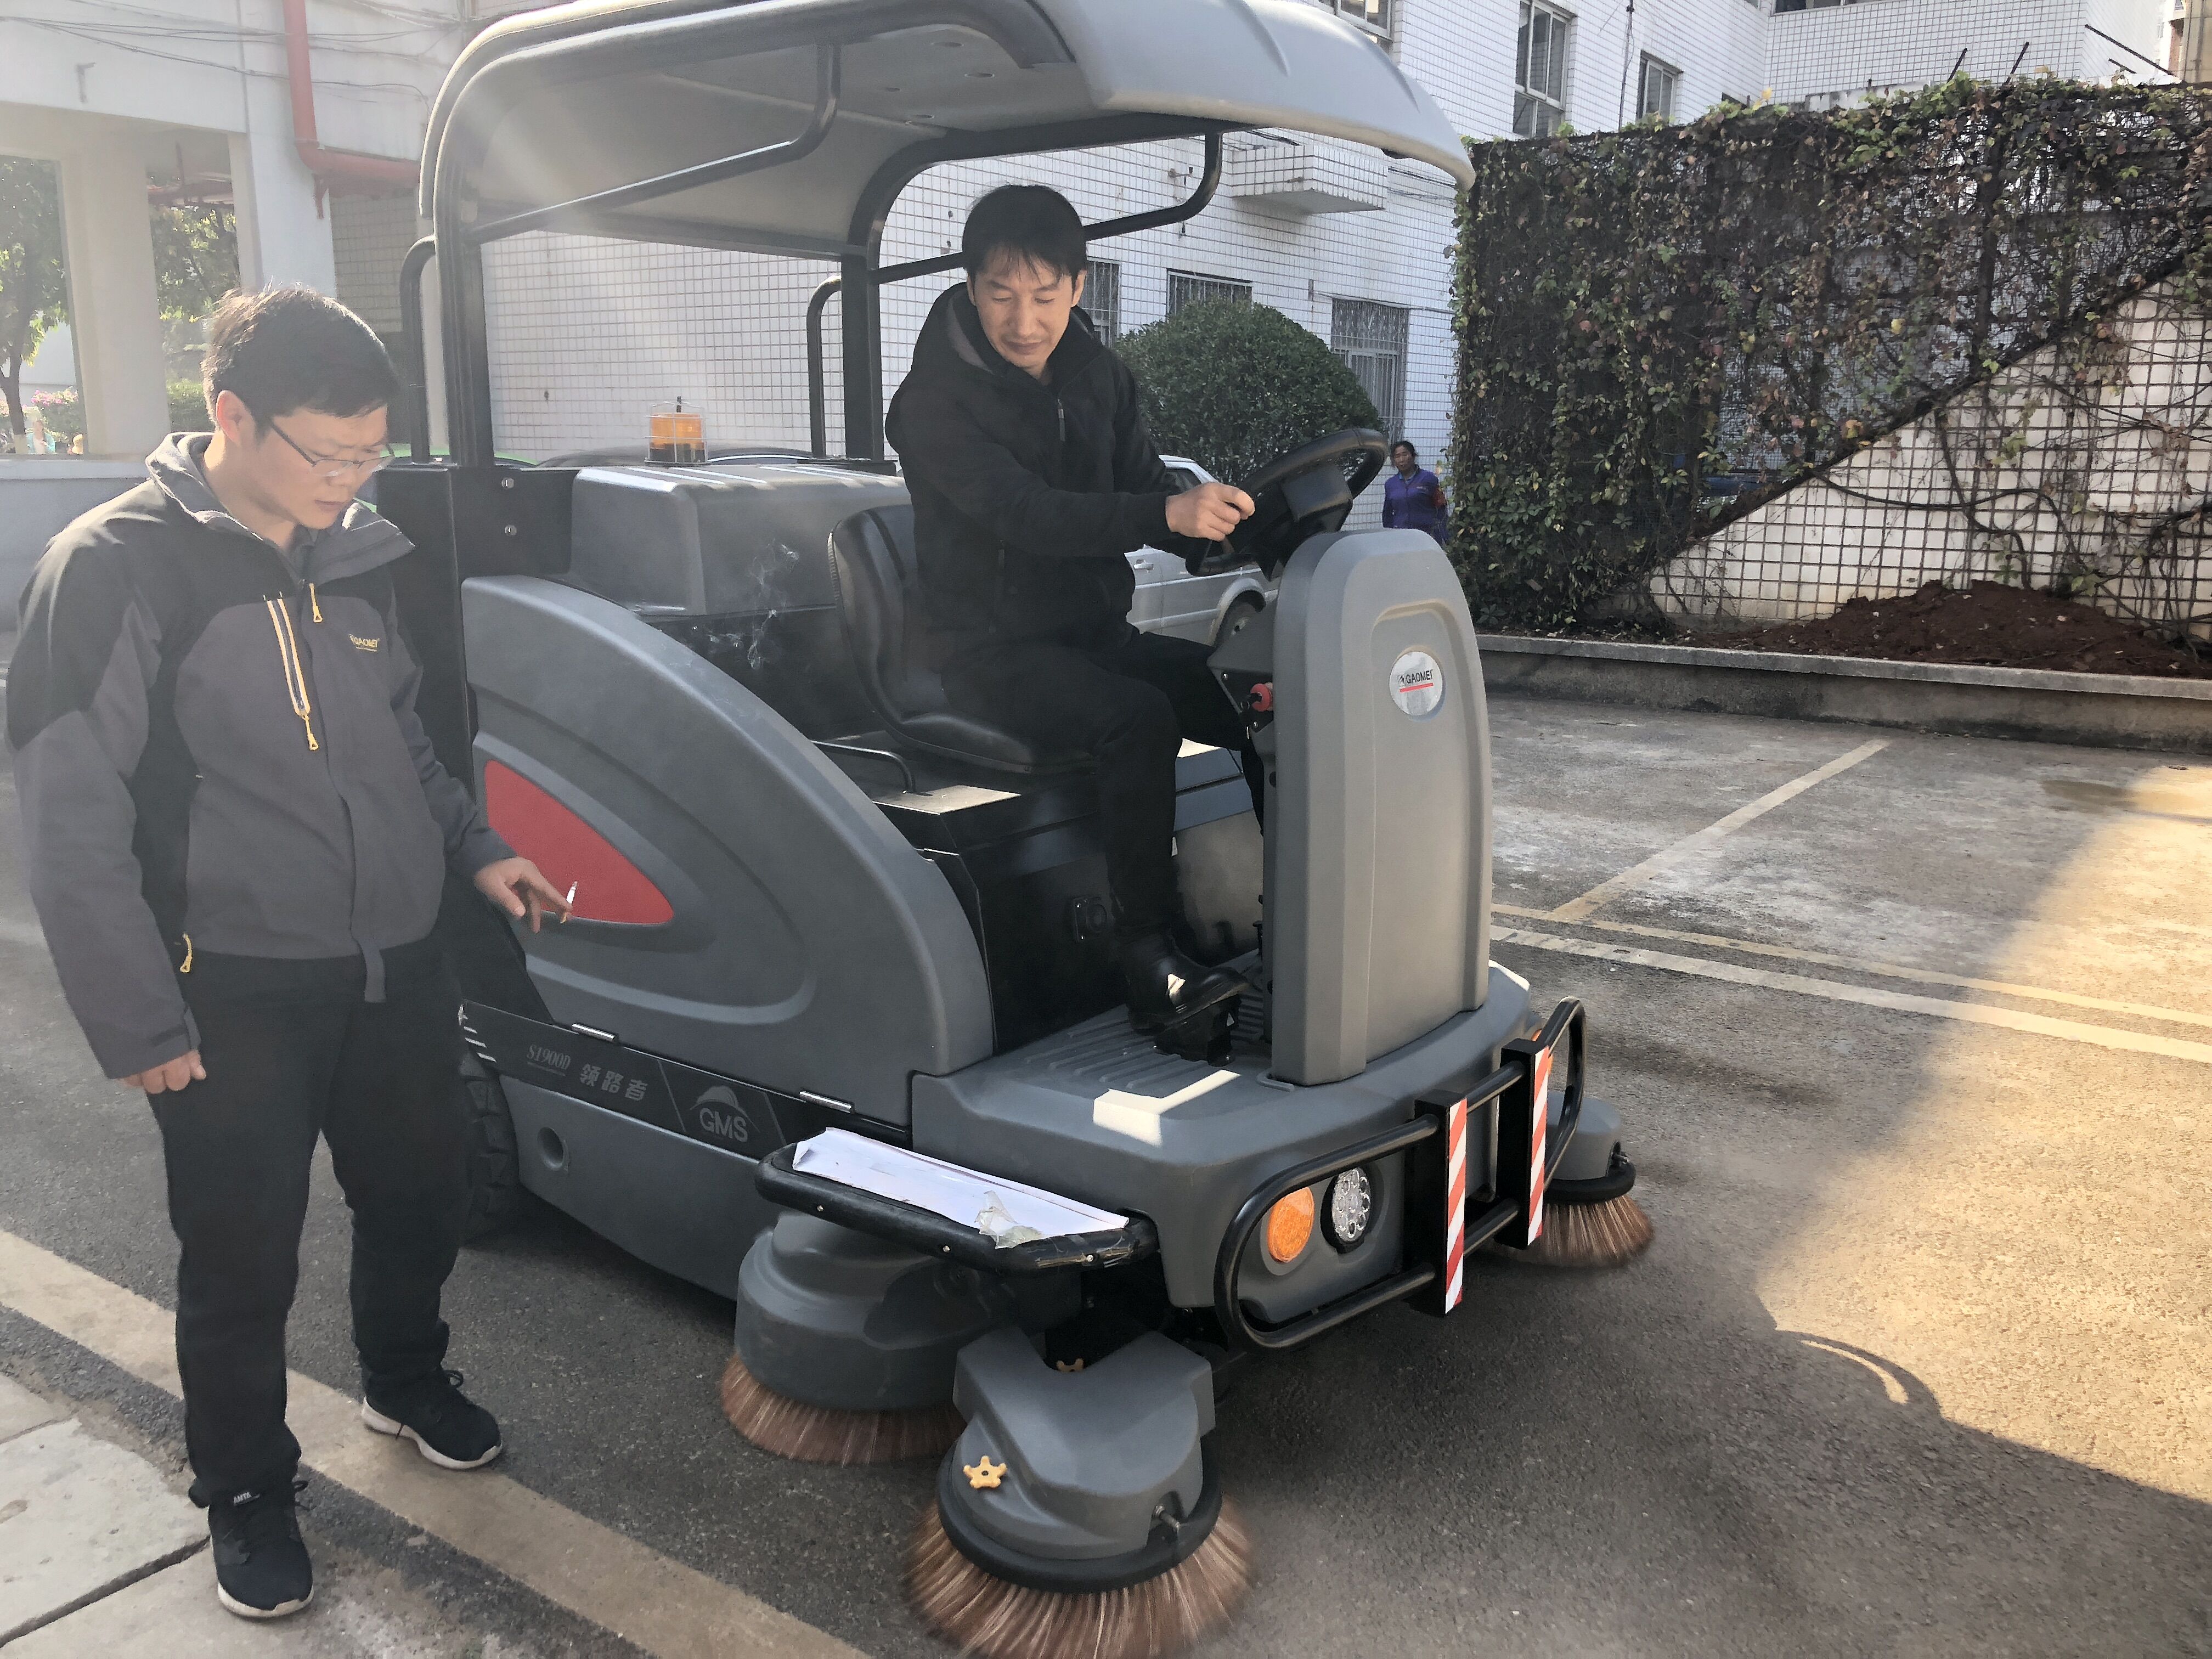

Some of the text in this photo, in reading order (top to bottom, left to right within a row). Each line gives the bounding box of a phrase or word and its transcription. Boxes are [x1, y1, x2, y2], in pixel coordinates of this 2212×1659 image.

[1406, 669, 1433, 684] GAOMEI
[527, 1044, 648, 1101] S1900D 领路者
[699, 1108, 748, 1142] GMS
